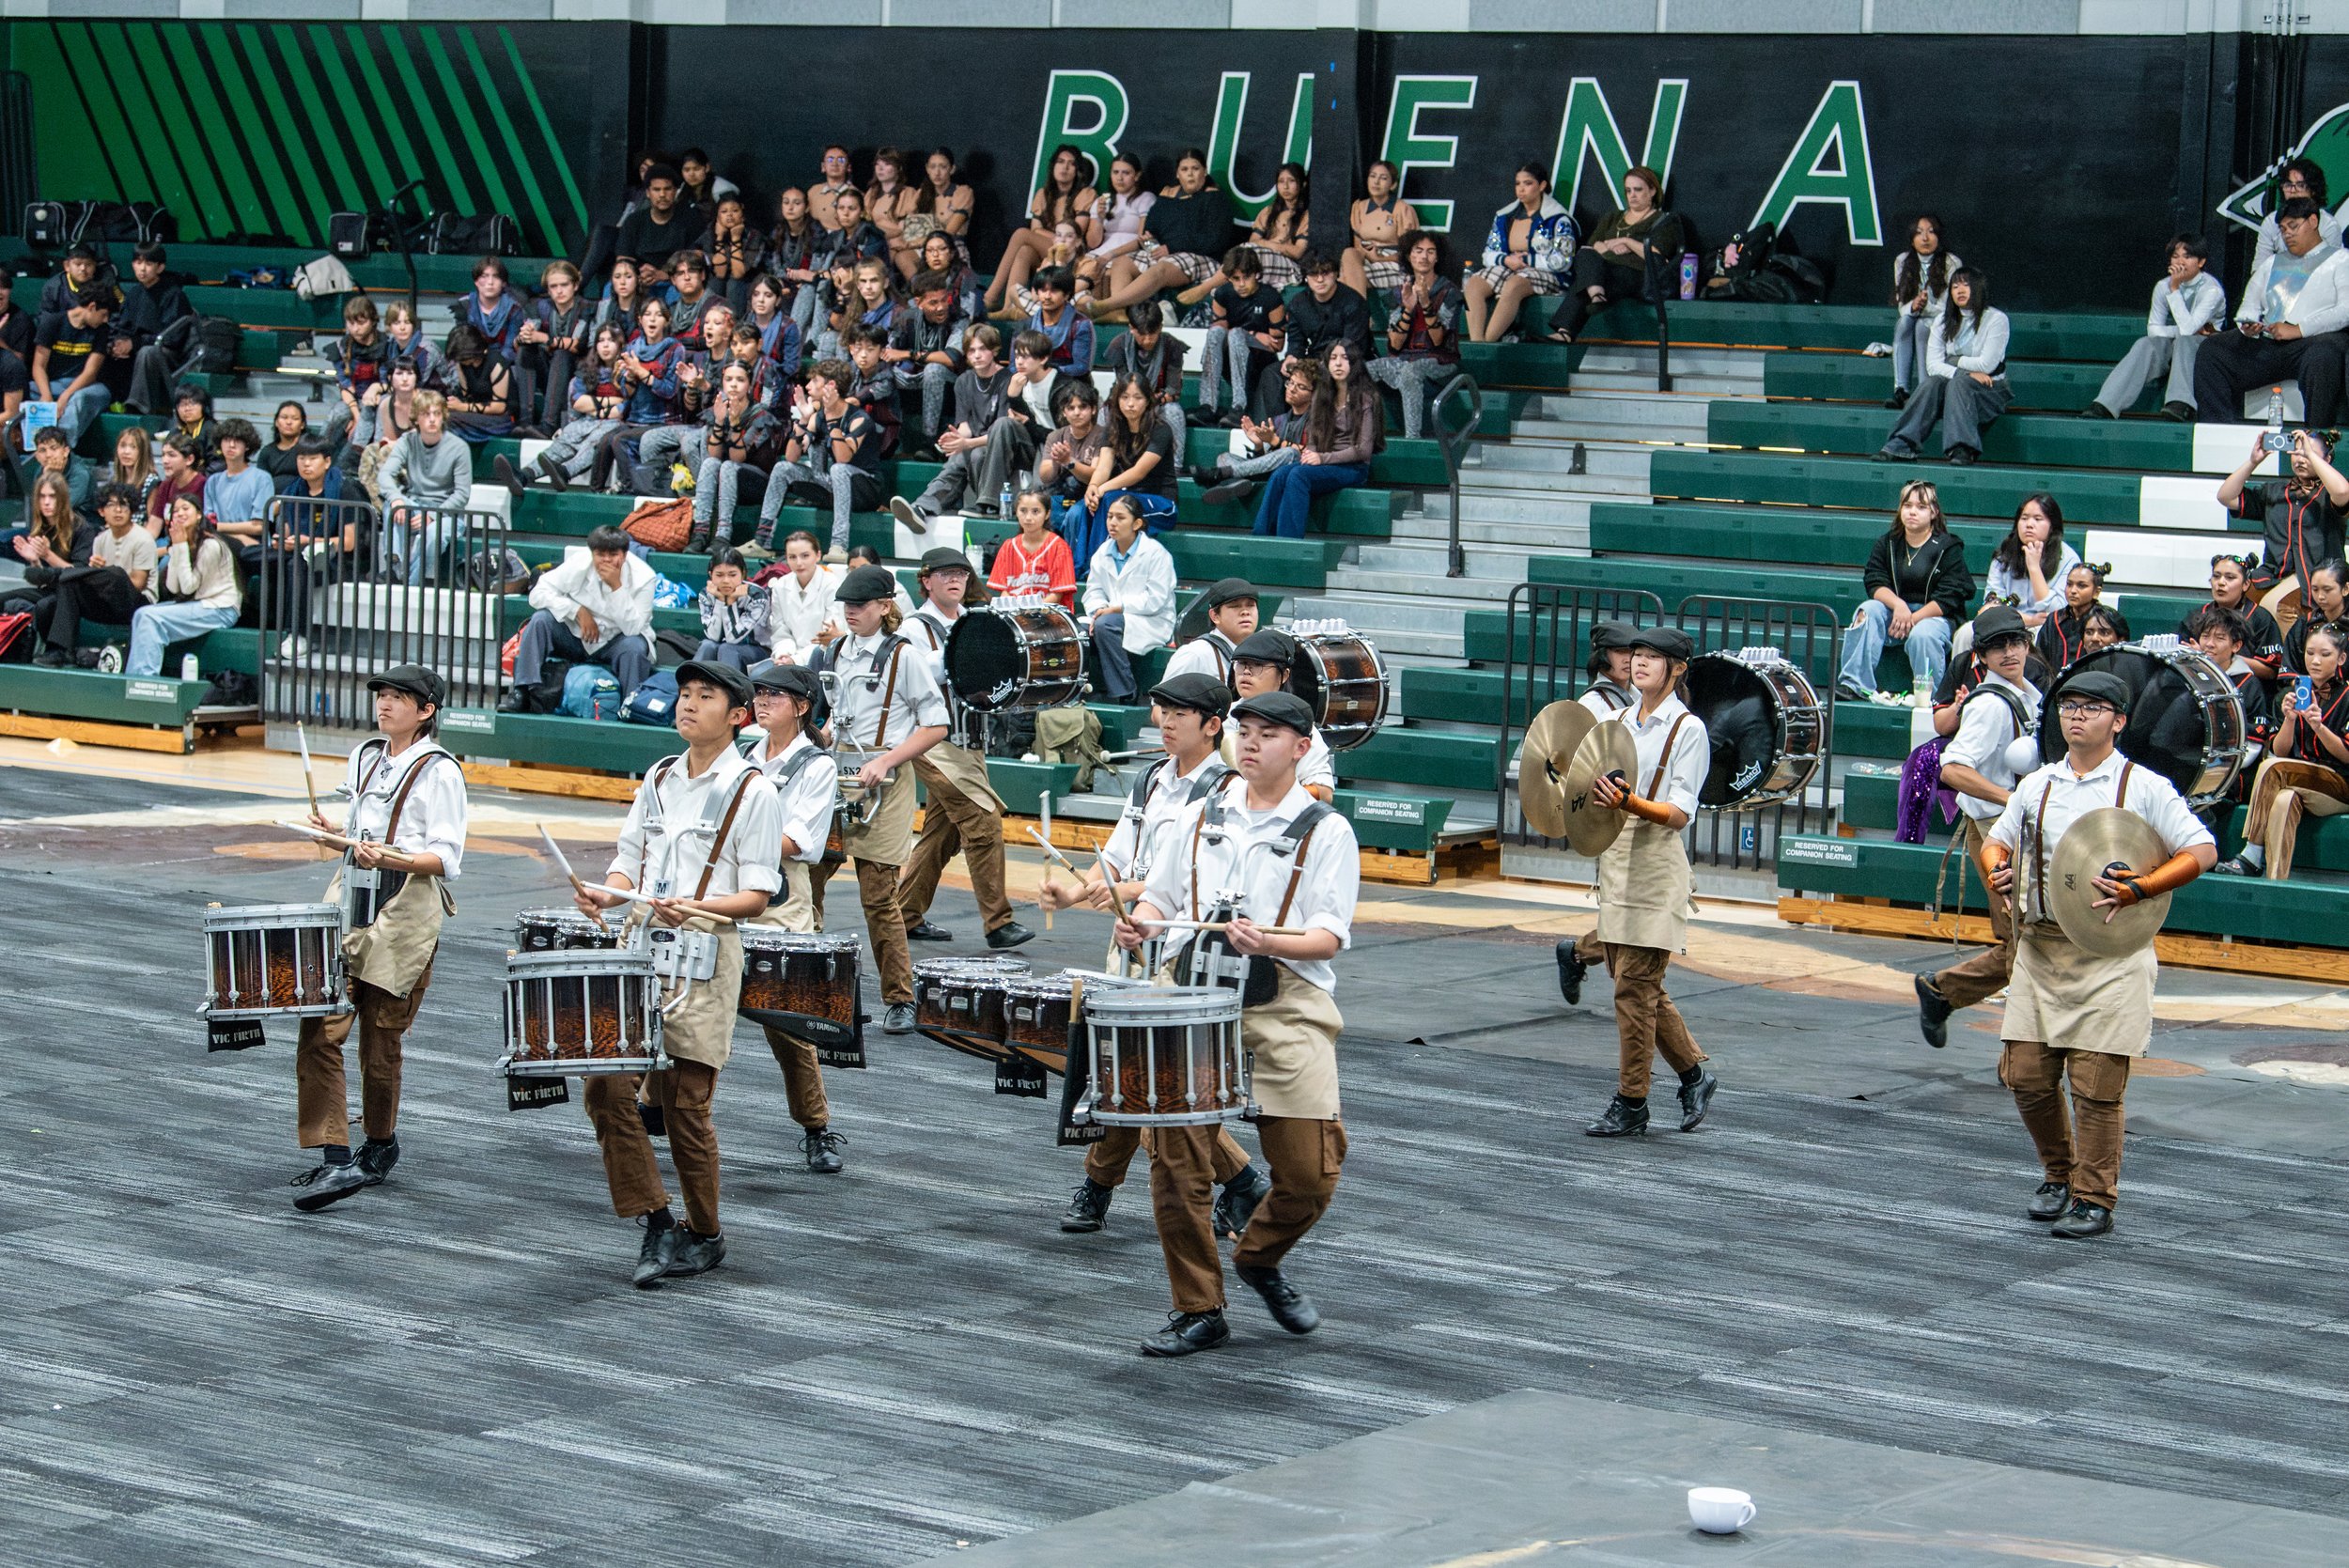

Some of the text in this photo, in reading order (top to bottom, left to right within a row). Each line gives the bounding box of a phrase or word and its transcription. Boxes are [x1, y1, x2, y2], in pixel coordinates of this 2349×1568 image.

[1026, 69, 1883, 246] BUENA
[1735, 768, 1759, 788] REMO
[1366, 800, 1412, 811] RESERVED FOR
[1359, 806, 1420, 819] COMPANION SEATING
[1794, 841, 1844, 853] RESERVED FOR
[1785, 848, 1852, 862] COMPANION SEATING
[657, 882, 667, 893] M
[816, 1021, 840, 1033] YAMAHA
[211, 1032, 230, 1044] VIC
[997, 1077, 1014, 1088] VIC
[512, 1084, 565, 1102] VIC FIRTH
